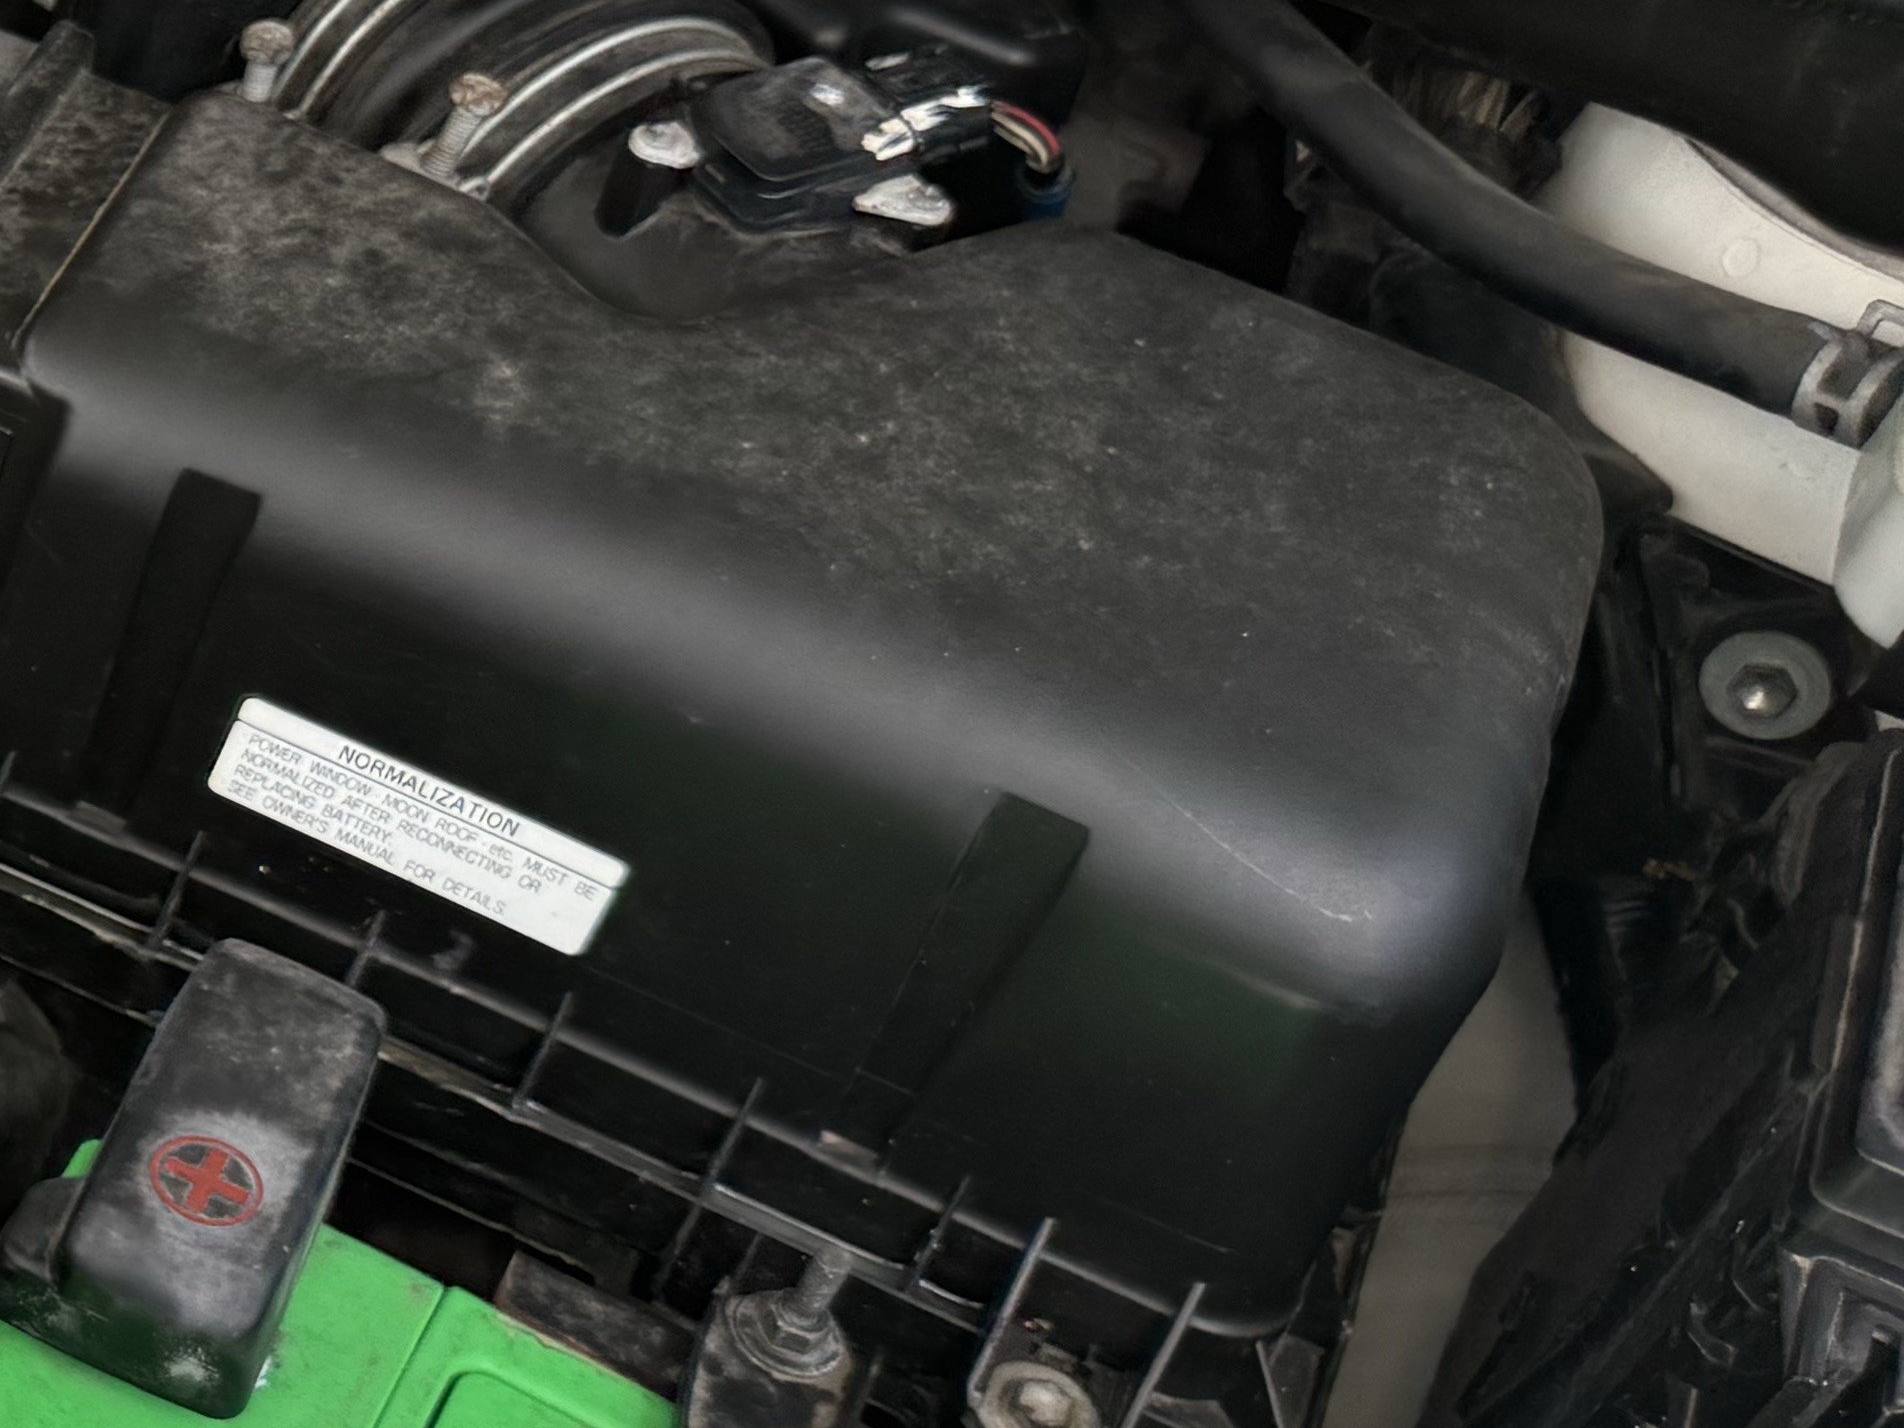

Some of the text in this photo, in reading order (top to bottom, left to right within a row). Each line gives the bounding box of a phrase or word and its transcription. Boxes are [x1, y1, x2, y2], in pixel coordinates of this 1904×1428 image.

[228, 780, 256, 801] SEE
[263, 796, 329, 833] OWNER'S
[335, 828, 393, 866] MANUAL
[403, 860, 436, 882] FOR
[235, 764, 316, 809] REPLACING
[241, 748, 542, 893] NORMALIZED AFTER RECONNECTING OR
[249, 734, 302, 764] POWER
[310, 762, 372, 796] WINDOW
[382, 794, 429, 823] MOON
[435, 818, 478, 841] ROOF
[523, 857, 569, 885] MUST
[574, 882, 598, 900] BE
[339, 746, 520, 836] NORMALIZATION
